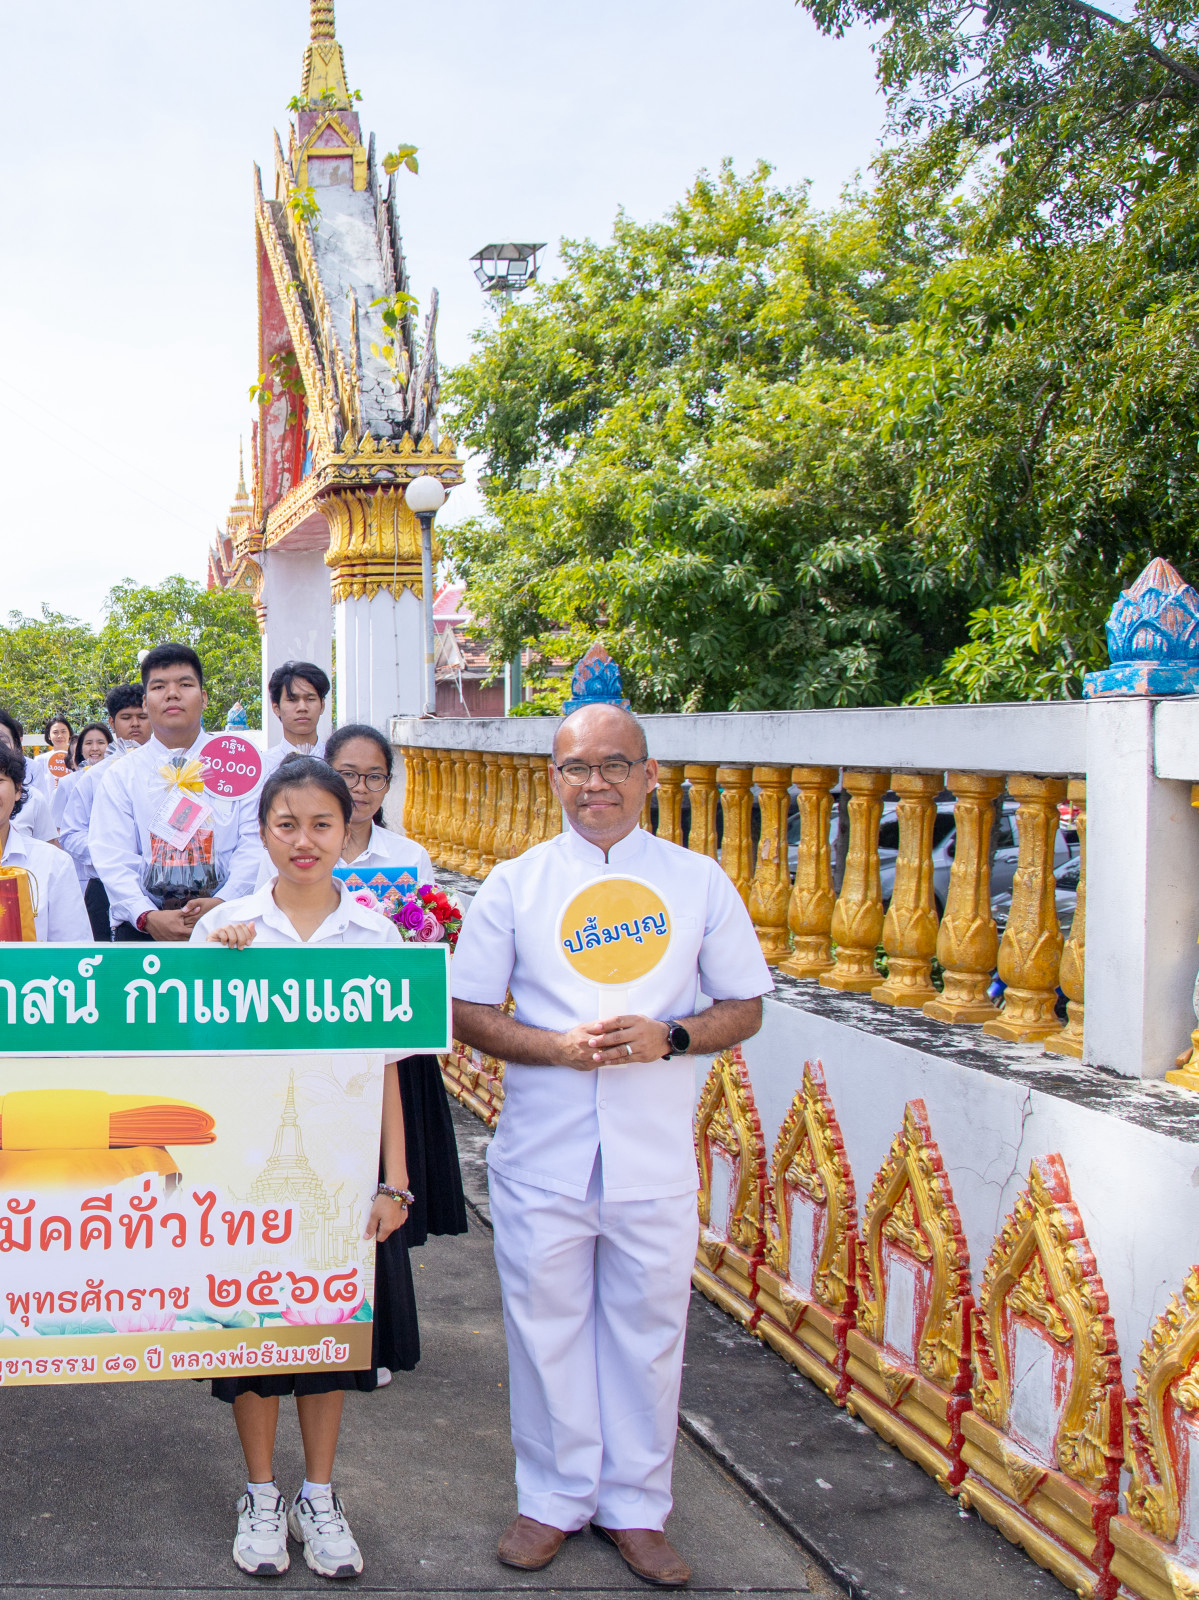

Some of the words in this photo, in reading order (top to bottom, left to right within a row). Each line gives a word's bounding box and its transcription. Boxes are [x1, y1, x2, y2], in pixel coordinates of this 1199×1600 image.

[221, 739, 246, 754] กฐิน
[204, 756, 256, 777] 30,000
[217, 779, 233, 793] วัด
[563, 912, 667, 953] ปลื้มบุญ
[123, 954, 414, 1024] กำแพงแสน
[5, 1279, 190, 1327] พุทธศักราช
[206, 1267, 358, 1308] ๒๕๖๘
[105, 1355, 136, 1373] ๘๑
[146, 1347, 162, 1370] ปี
[172, 1339, 349, 1369] หลวงพ่อธัมมชโย
